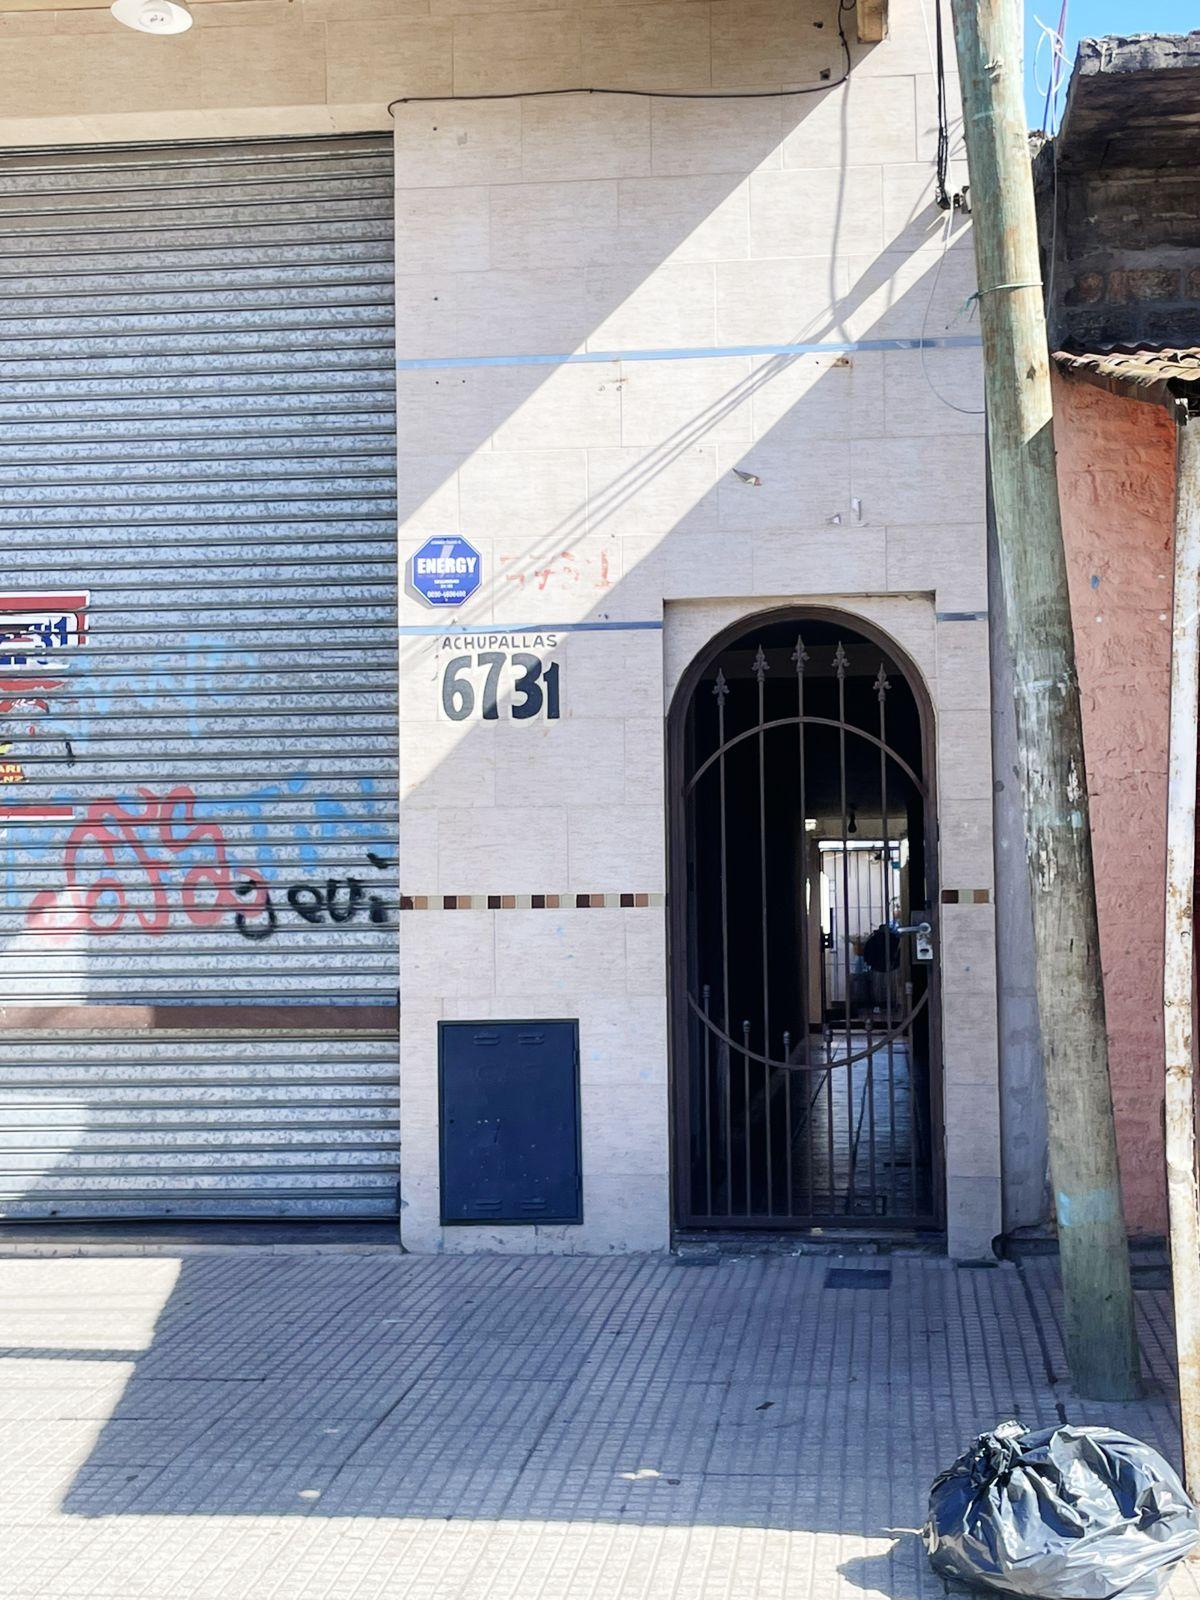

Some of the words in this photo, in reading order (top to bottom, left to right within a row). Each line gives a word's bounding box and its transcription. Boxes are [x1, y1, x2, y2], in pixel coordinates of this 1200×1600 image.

[417, 557, 476, 574] ENERGY
[442, 634, 557, 650] ACHUPALLAS
[442, 651, 560, 721] 6731
